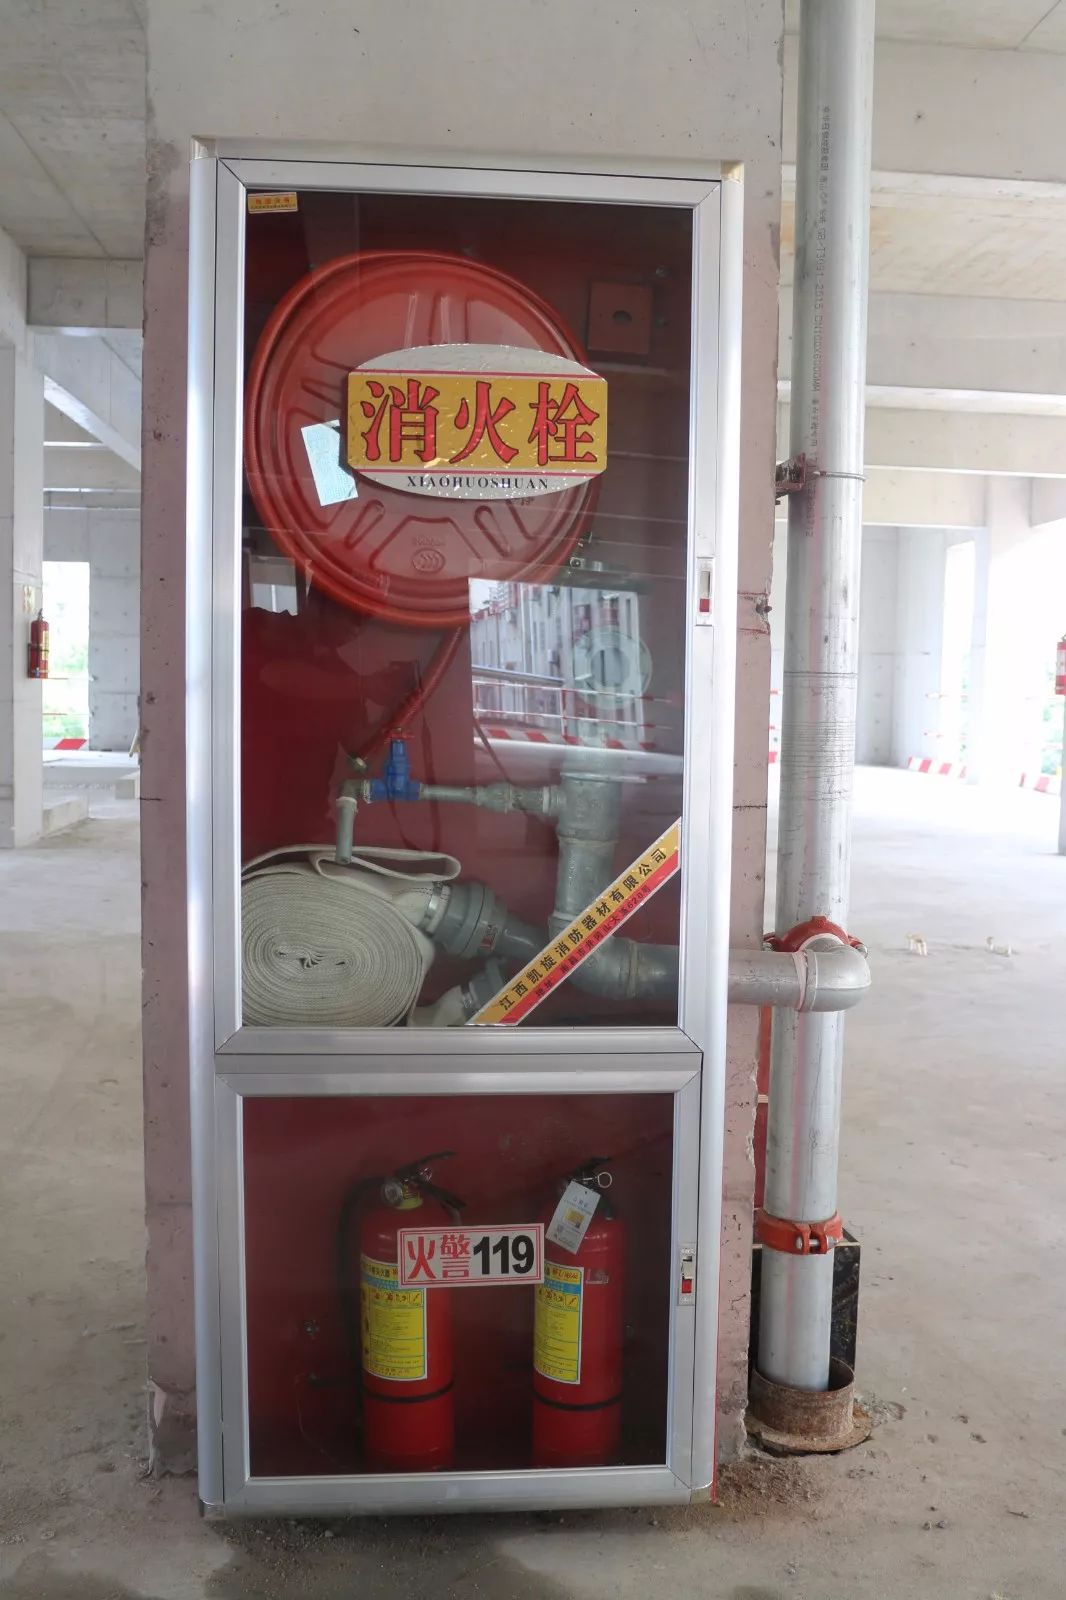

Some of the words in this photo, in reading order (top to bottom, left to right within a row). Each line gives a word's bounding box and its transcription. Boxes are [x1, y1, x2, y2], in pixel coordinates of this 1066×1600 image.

[360, 378, 600, 467] 消火栓
[407, 475, 549, 489] XIAOHUOSHUAN
[499, 847, 668, 1011] 江西凯旋消防器材有限公司
